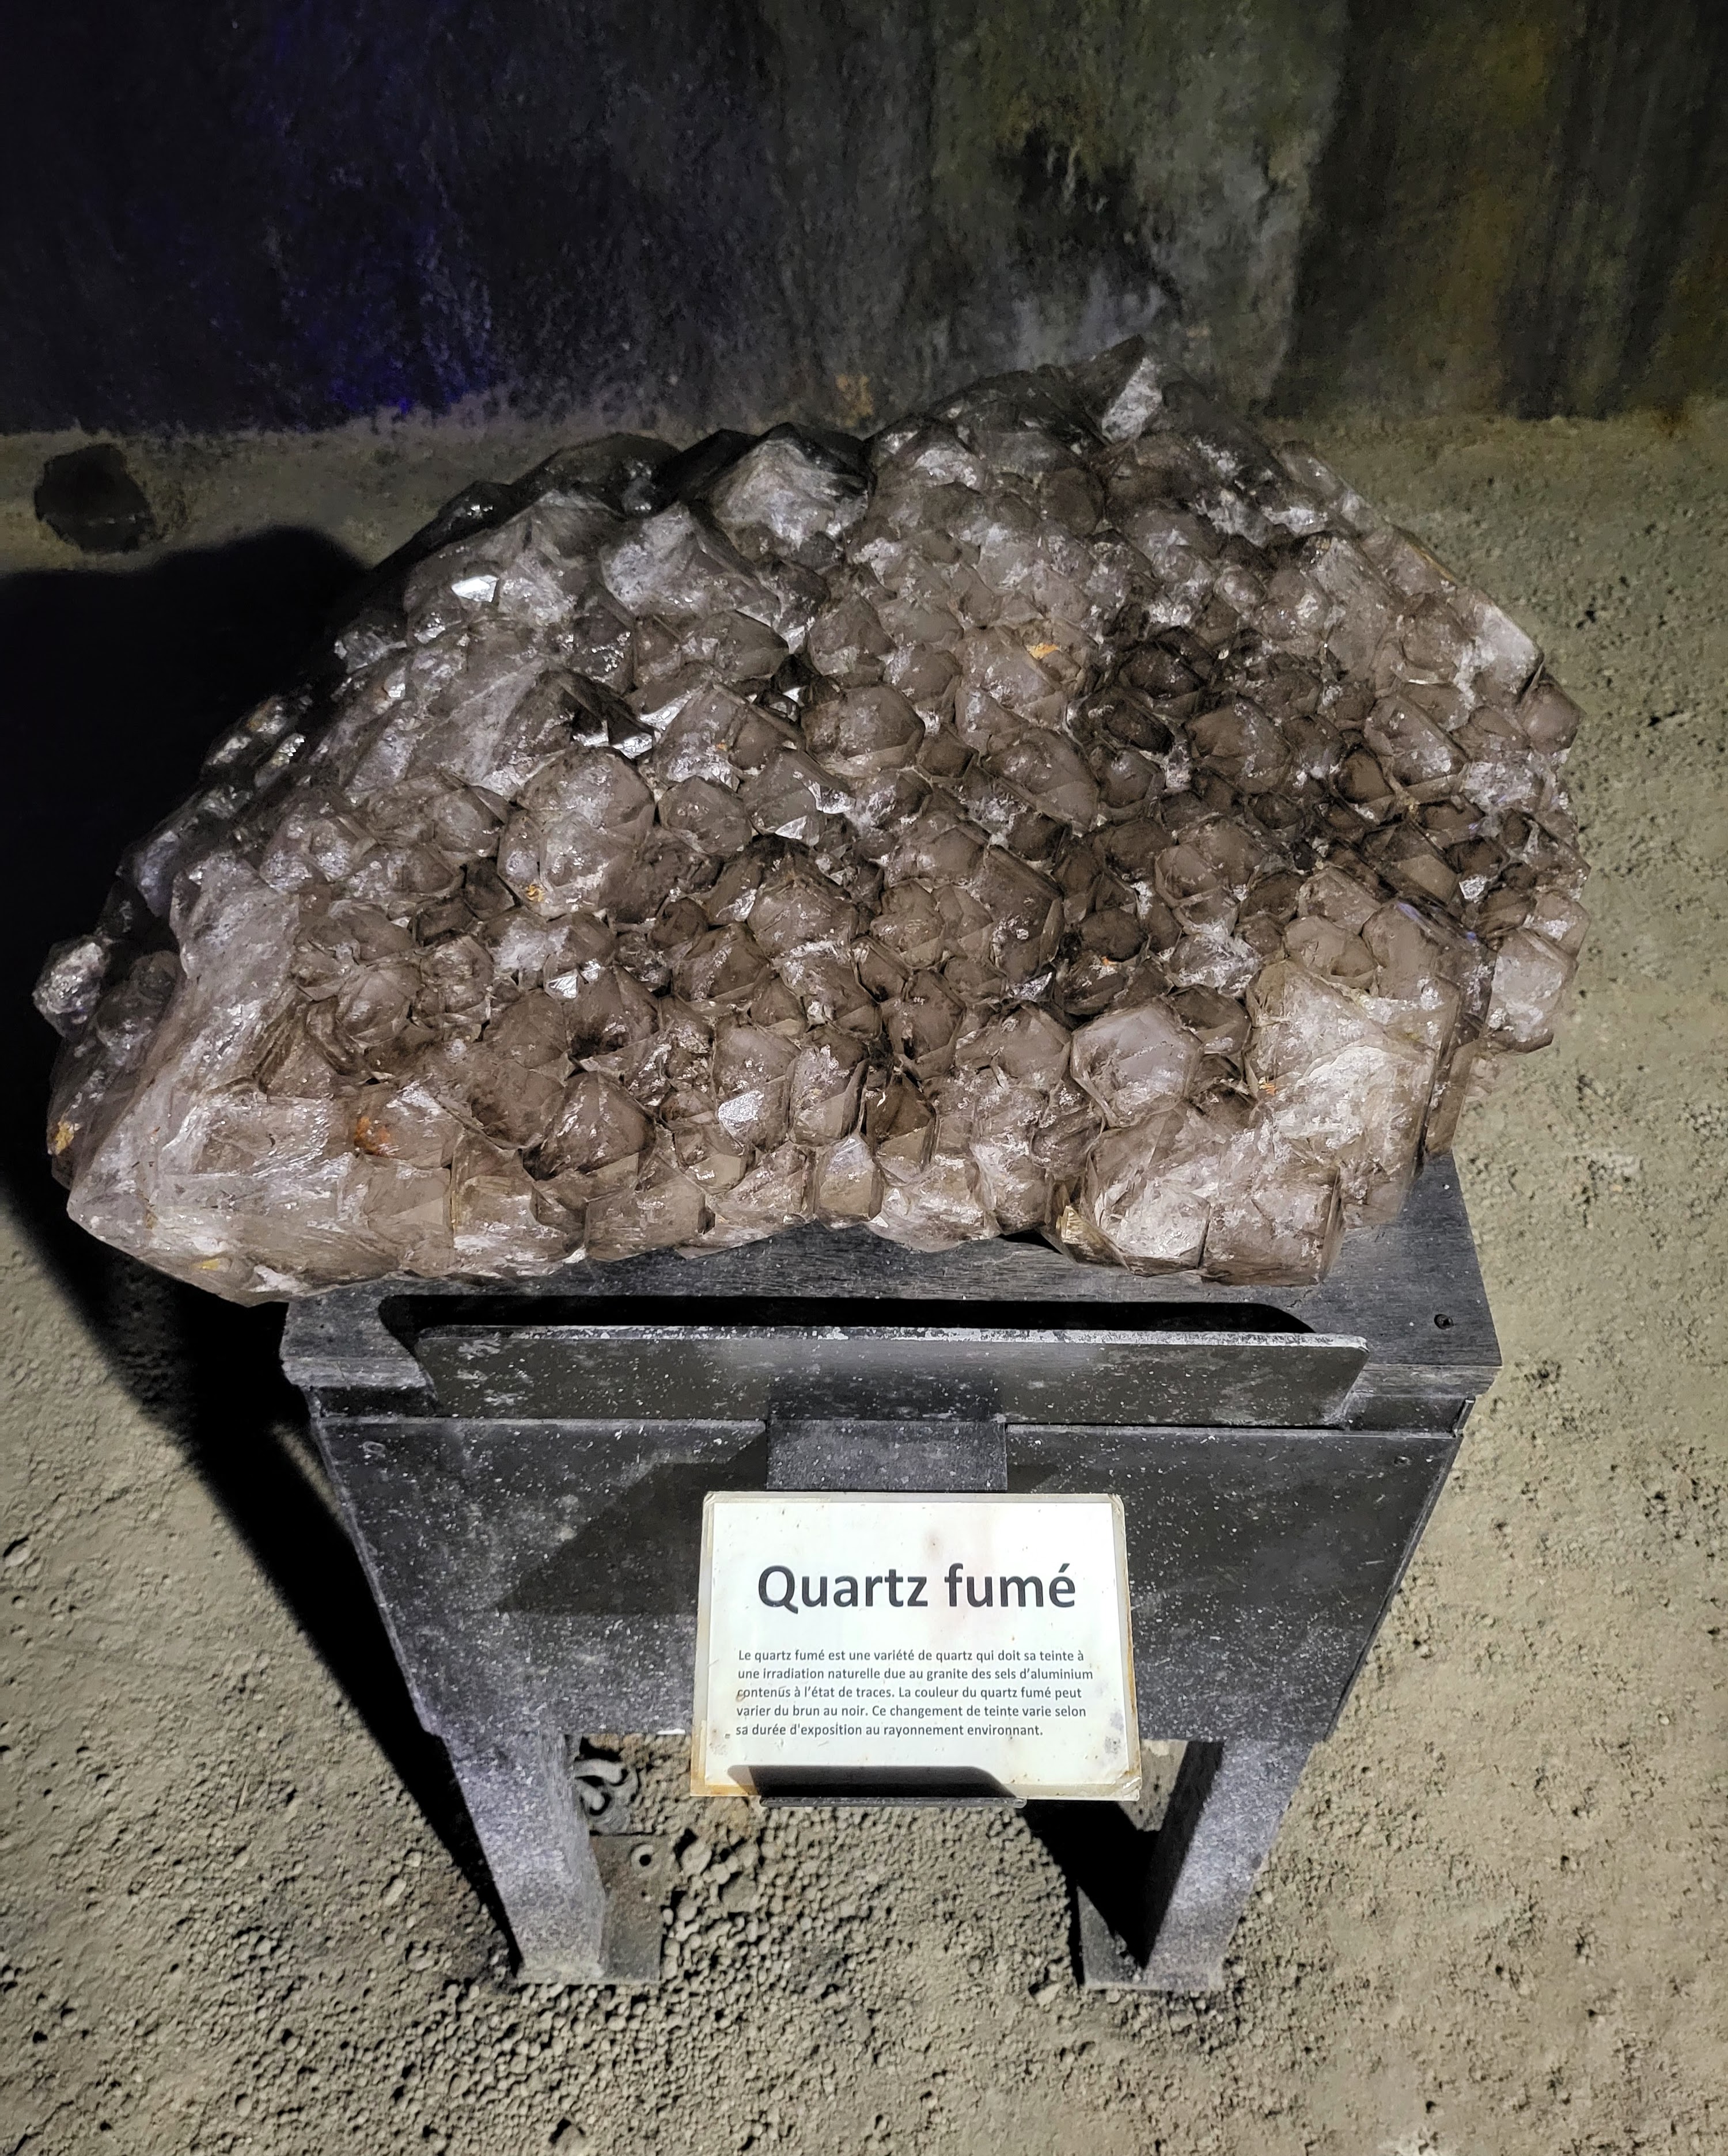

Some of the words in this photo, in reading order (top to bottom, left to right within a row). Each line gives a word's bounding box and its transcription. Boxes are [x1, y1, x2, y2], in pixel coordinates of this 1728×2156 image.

[758, 1565, 929, 1615] Quartz
[944, 1562, 1076, 1608] fumé
[738, 1650, 751, 1661] Le
[755, 1650, 791, 1663] quartz
[795, 1649, 825, 1661] fumé
[828, 1650, 846, 1661] est
[849, 1652, 870, 1661] une
[873, 1649, 915, 1661] variété
[918, 1649, 933, 1661] de
[935, 1650, 973, 1664] quartz
[976, 1650, 994, 1664] qui
[998, 1649, 1021, 1661] doit
[1024, 1652, 1036, 1661] sa
[1039, 1650, 1074, 1661] teinte
[1077, 1649, 1084, 1661] à
[738, 1671, 760, 1679] une
[763, 1667, 824, 1679] irradiation
[828, 1667, 880, 1679] naturelle
[884, 1667, 905, 1679] due
[909, 1671, 923, 1679] au
[926, 1668, 968, 1681] granite
[971, 1668, 991, 1679] des
[995, 1668, 1016, 1679] sels
[737, 1687, 791, 1698] contenus
[794, 1686, 801, 1698] à
[838, 1686, 852, 1698] de
[856, 1687, 895, 1698] traces.
[899, 1687, 911, 1698] La
[915, 1686, 959, 1698] couleur
[962, 1686, 976, 1698] du
[980, 1687, 1018, 1700] quartz
[1021, 1686, 1051, 1698] fumé
[1055, 1688, 1082, 1701] peut
[736, 1705, 771, 1717] varier
[774, 1705, 789, 1716] du
[793, 1705, 820, 1716] brun
[823, 1707, 838, 1716] au
[842, 1705, 868, 1716] noir.
[872, 1705, 886, 1716] Ce
[890, 1705, 963, 1719] changement
[966, 1705, 981, 1717] de
[984, 1705, 1019, 1717] teinte
[1022, 1705, 1051, 1717] varie
[1055, 1705, 1086, 1717] selon
[736, 1726, 748, 1735] sa
[752, 1723, 786, 1735] durée
[866, 1726, 880, 1735] au
[884, 1725, 964, 1738] rayonnement
[967, 1724, 1043, 1736] environnant.
